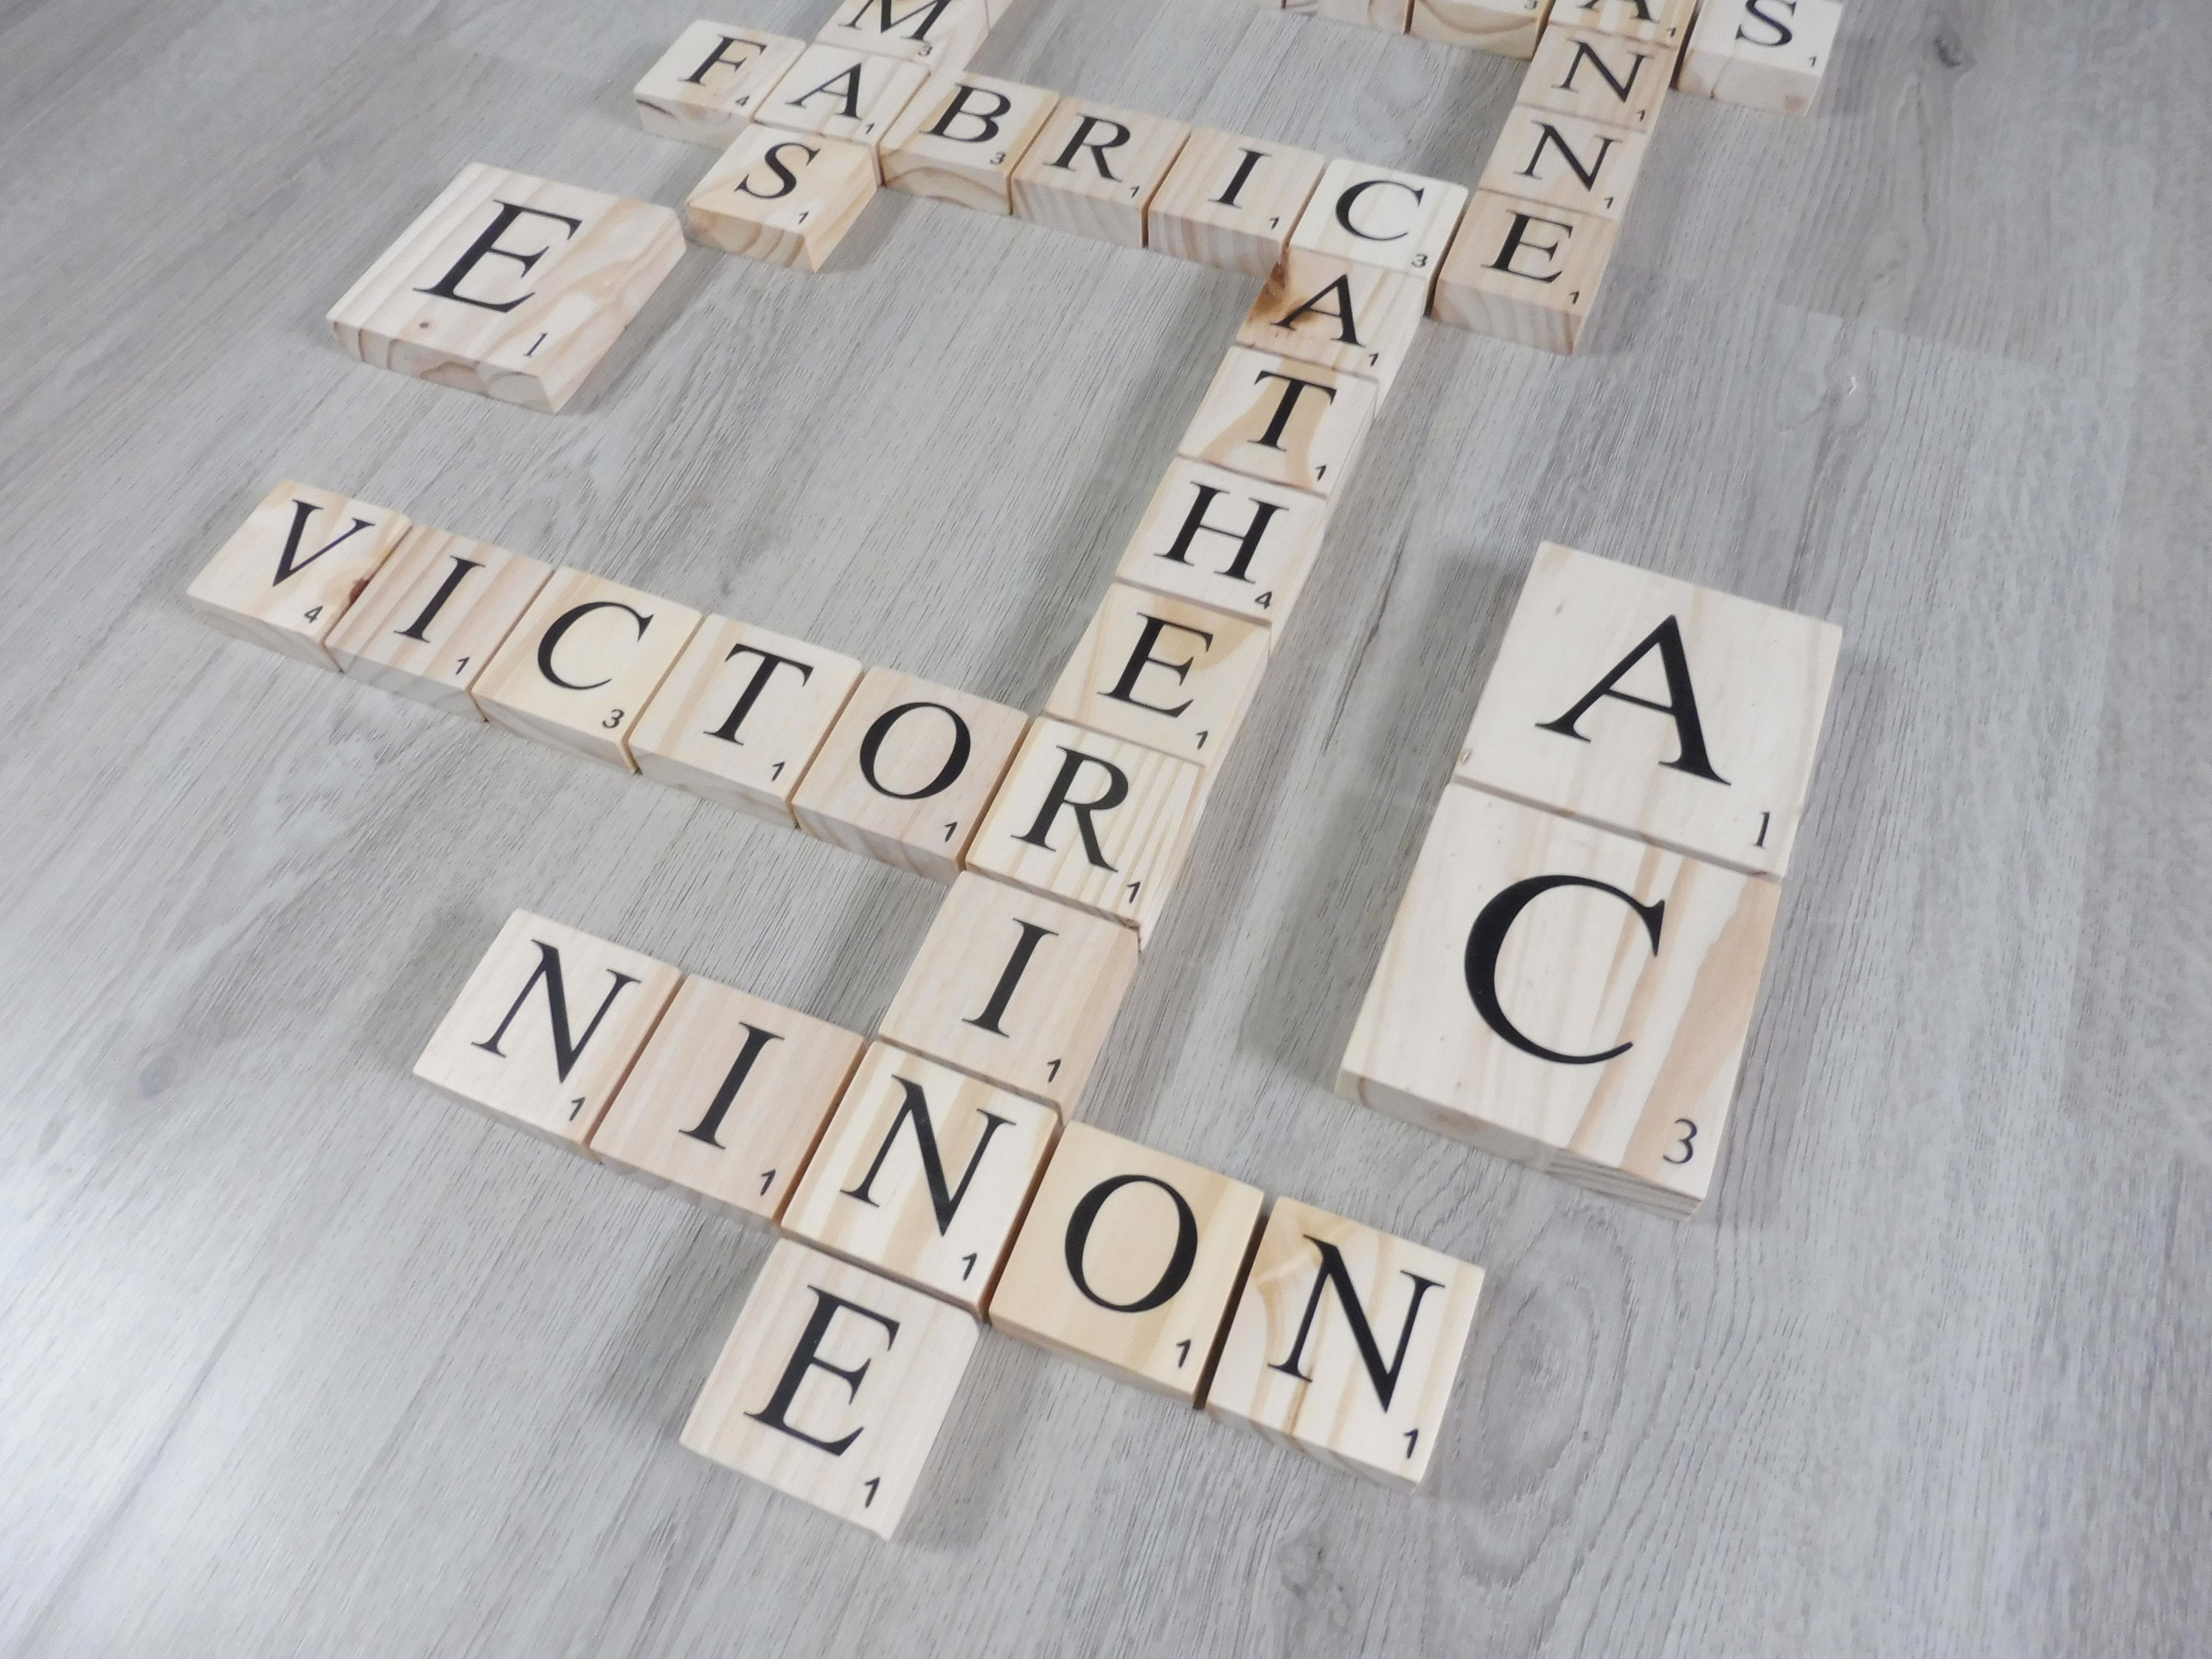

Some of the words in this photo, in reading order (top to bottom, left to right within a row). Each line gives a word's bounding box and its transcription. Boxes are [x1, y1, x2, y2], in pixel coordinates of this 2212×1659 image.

[1667, 27, 1677, 38] 1
[917, 42, 933, 57] 3
[1807, 56, 1818, 68] 1
[735, 95, 750, 107] 4
[1636, 109, 1646, 122] 1
[866, 122, 874, 134] 1
[990, 153, 1006, 164] 3
[1131, 186, 1140, 198] 1
[1604, 196, 1615, 209] 1
[799, 212, 809, 223] 1
[1270, 217, 1279, 229] 1
[411, 199, 583, 315] E
[1411, 253, 1429, 268] 3
[1569, 291, 1581, 305] 1
[523, 333, 548, 358] 1
[1367, 352, 1380, 367] 1
[1315, 465, 1326, 481] 1
[1254, 591, 1273, 609] 4
[304, 605, 324, 623] 4
[456, 657, 470, 675] 1
[602, 709, 625, 728] 3
[1195, 731, 1209, 751] 1
[771, 762, 785, 782] 1
[945, 821, 958, 842] 1
[1753, 811, 1771, 849] 1
[1127, 881, 1141, 903] 1
[1047, 1058, 1062, 1083] 1
[569, 1096, 585, 1121] 1
[1661, 1118, 1698, 1165] 3
[760, 1169, 776, 1196] 1
[962, 1253, 978, 1281] 1
[1177, 1339, 1192, 1368] 1
[1405, 1428, 1419, 1459] 1
[865, 1477, 880, 1508] 1
